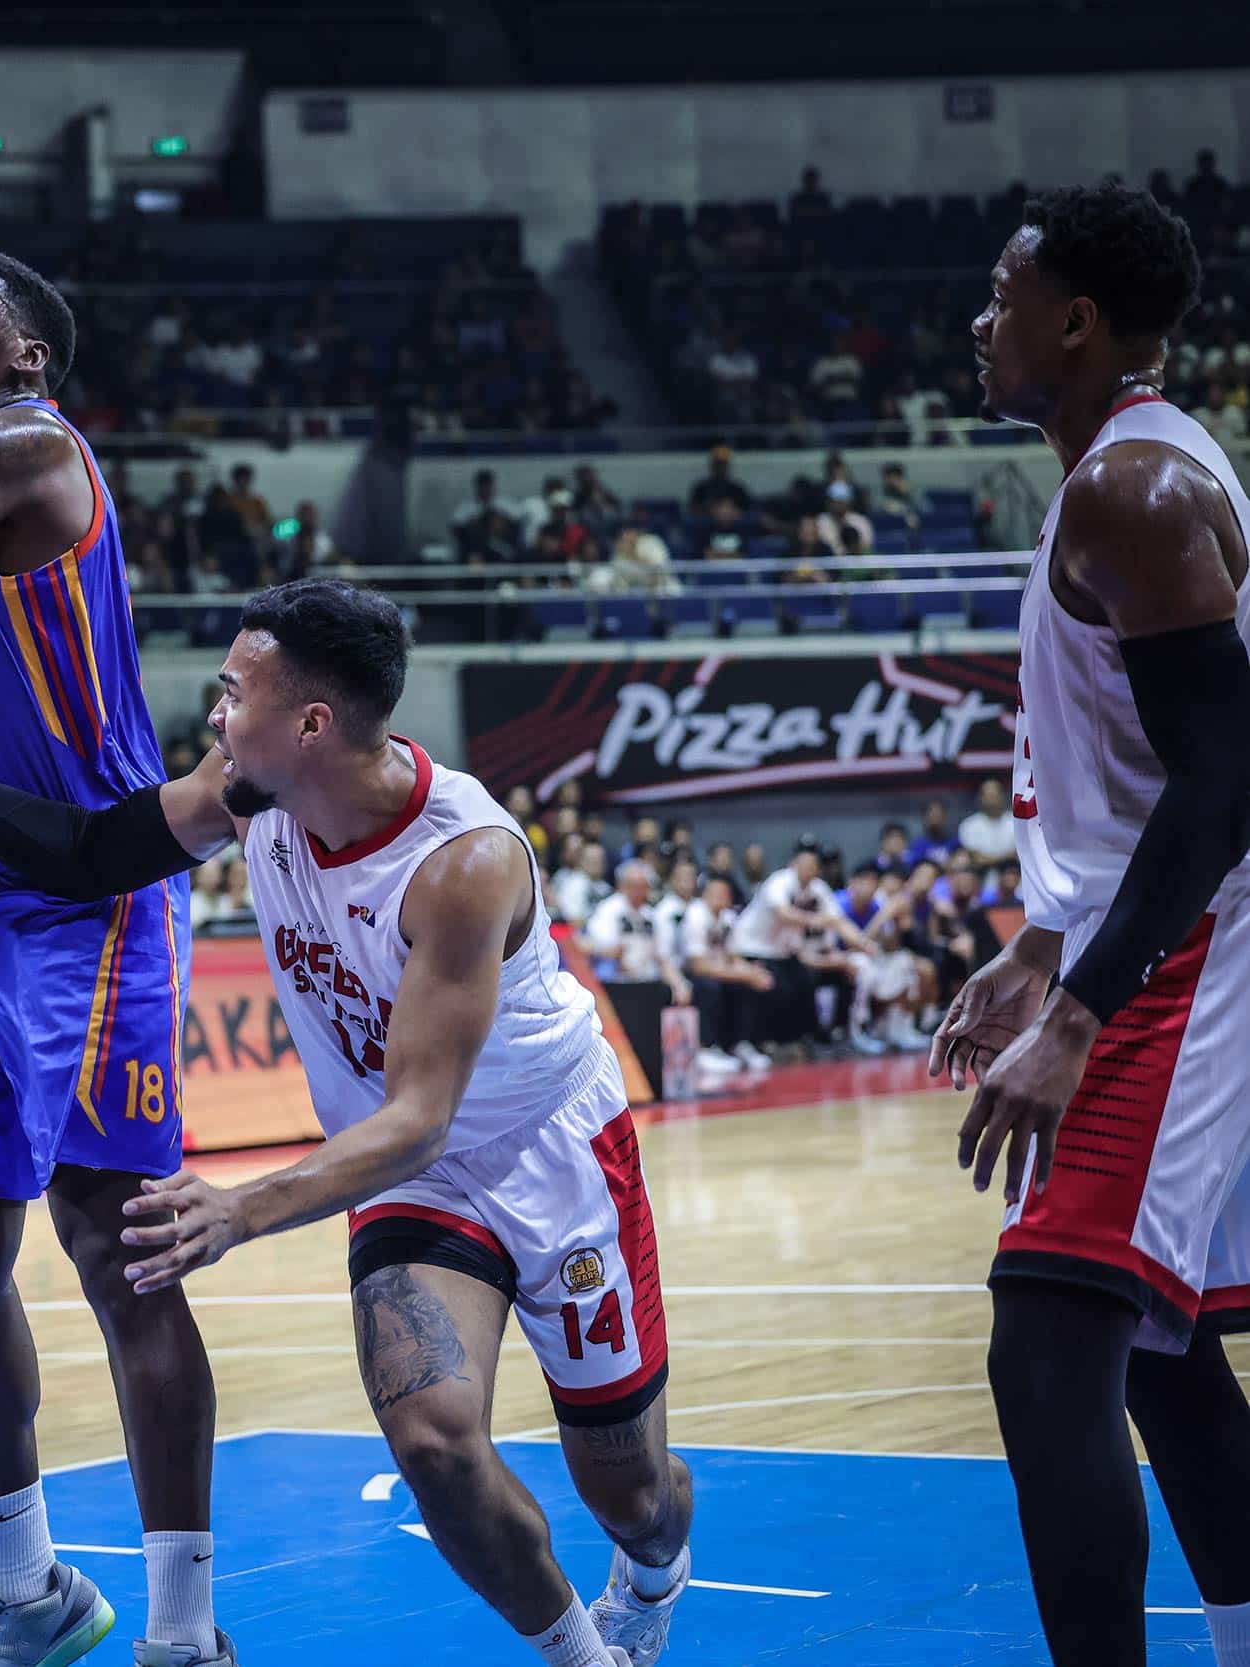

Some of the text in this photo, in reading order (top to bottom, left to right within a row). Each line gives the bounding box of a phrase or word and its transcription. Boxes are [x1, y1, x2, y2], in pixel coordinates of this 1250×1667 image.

[596, 681, 827, 779] Pizza
[830, 680, 1004, 764] Hut
[124, 1058, 167, 1124] 18
[559, 1288, 626, 1360] 14
